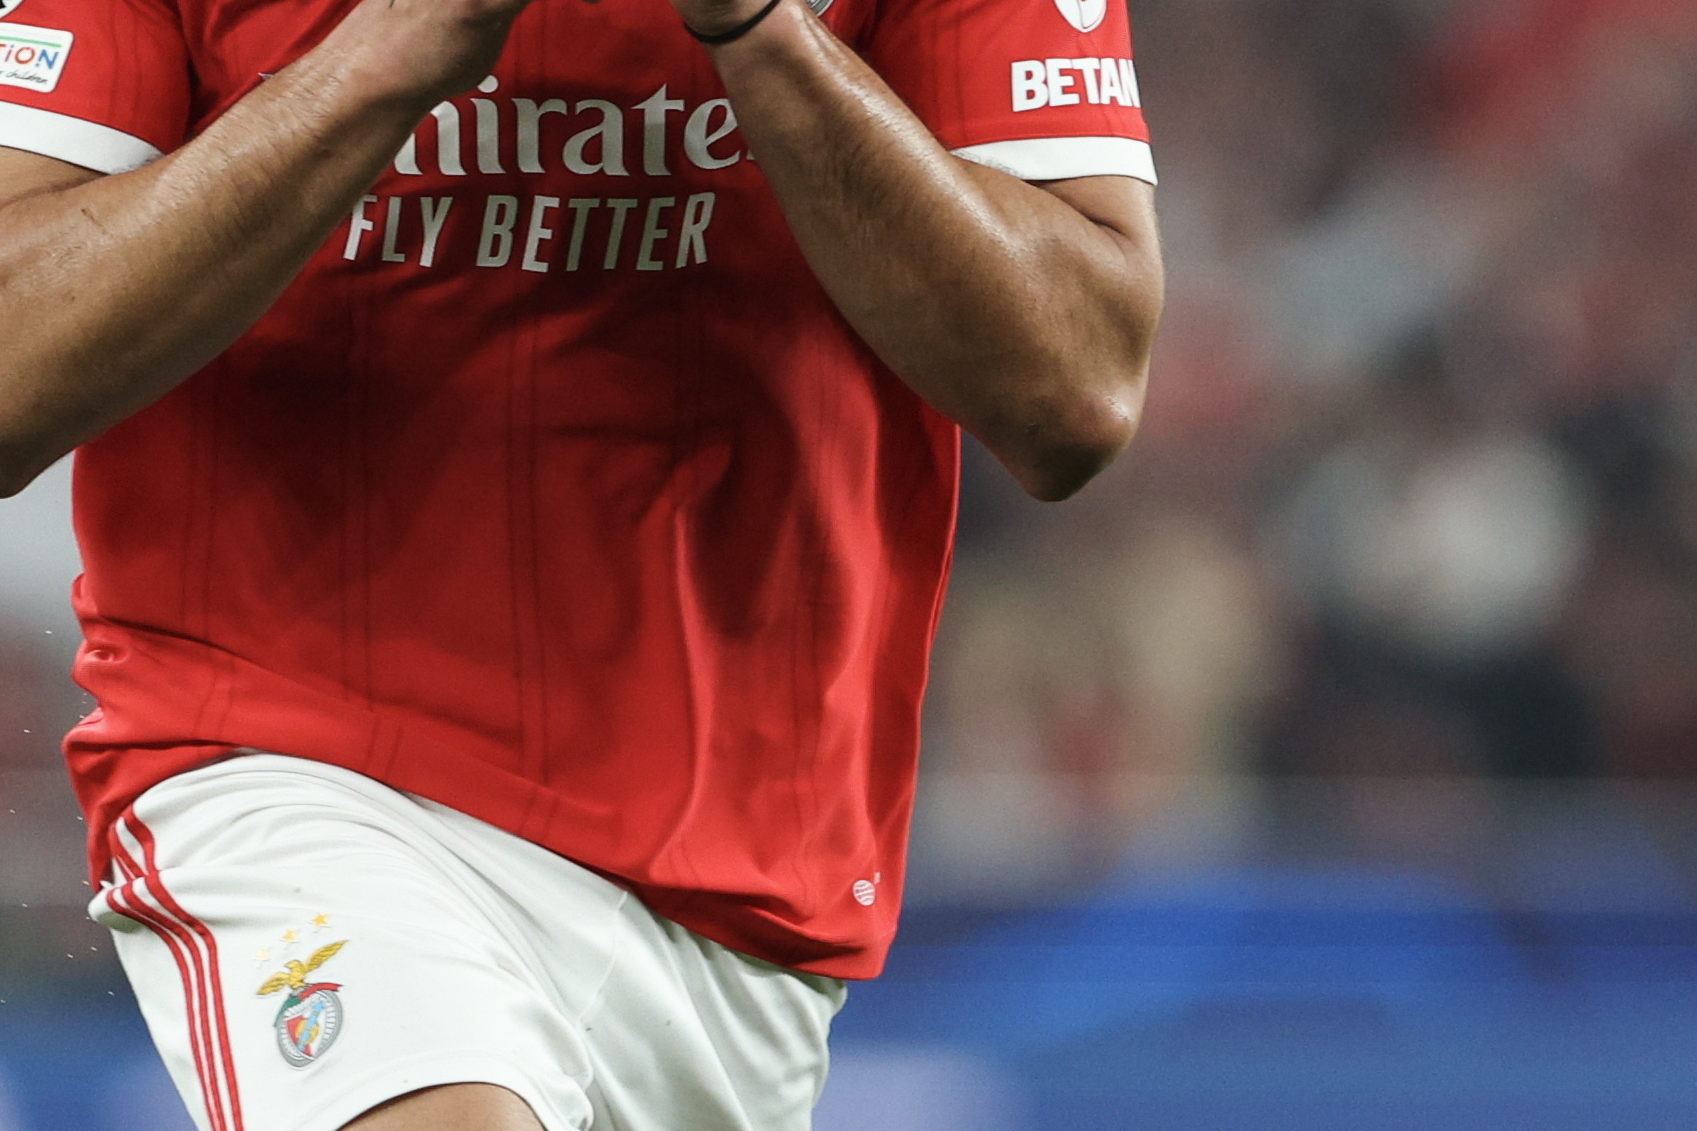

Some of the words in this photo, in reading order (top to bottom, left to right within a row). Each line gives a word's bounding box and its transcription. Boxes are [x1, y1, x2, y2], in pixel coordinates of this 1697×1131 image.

[394, 74, 755, 177] irate
[343, 193, 454, 268] FLY
[475, 191, 716, 273] BETTER
